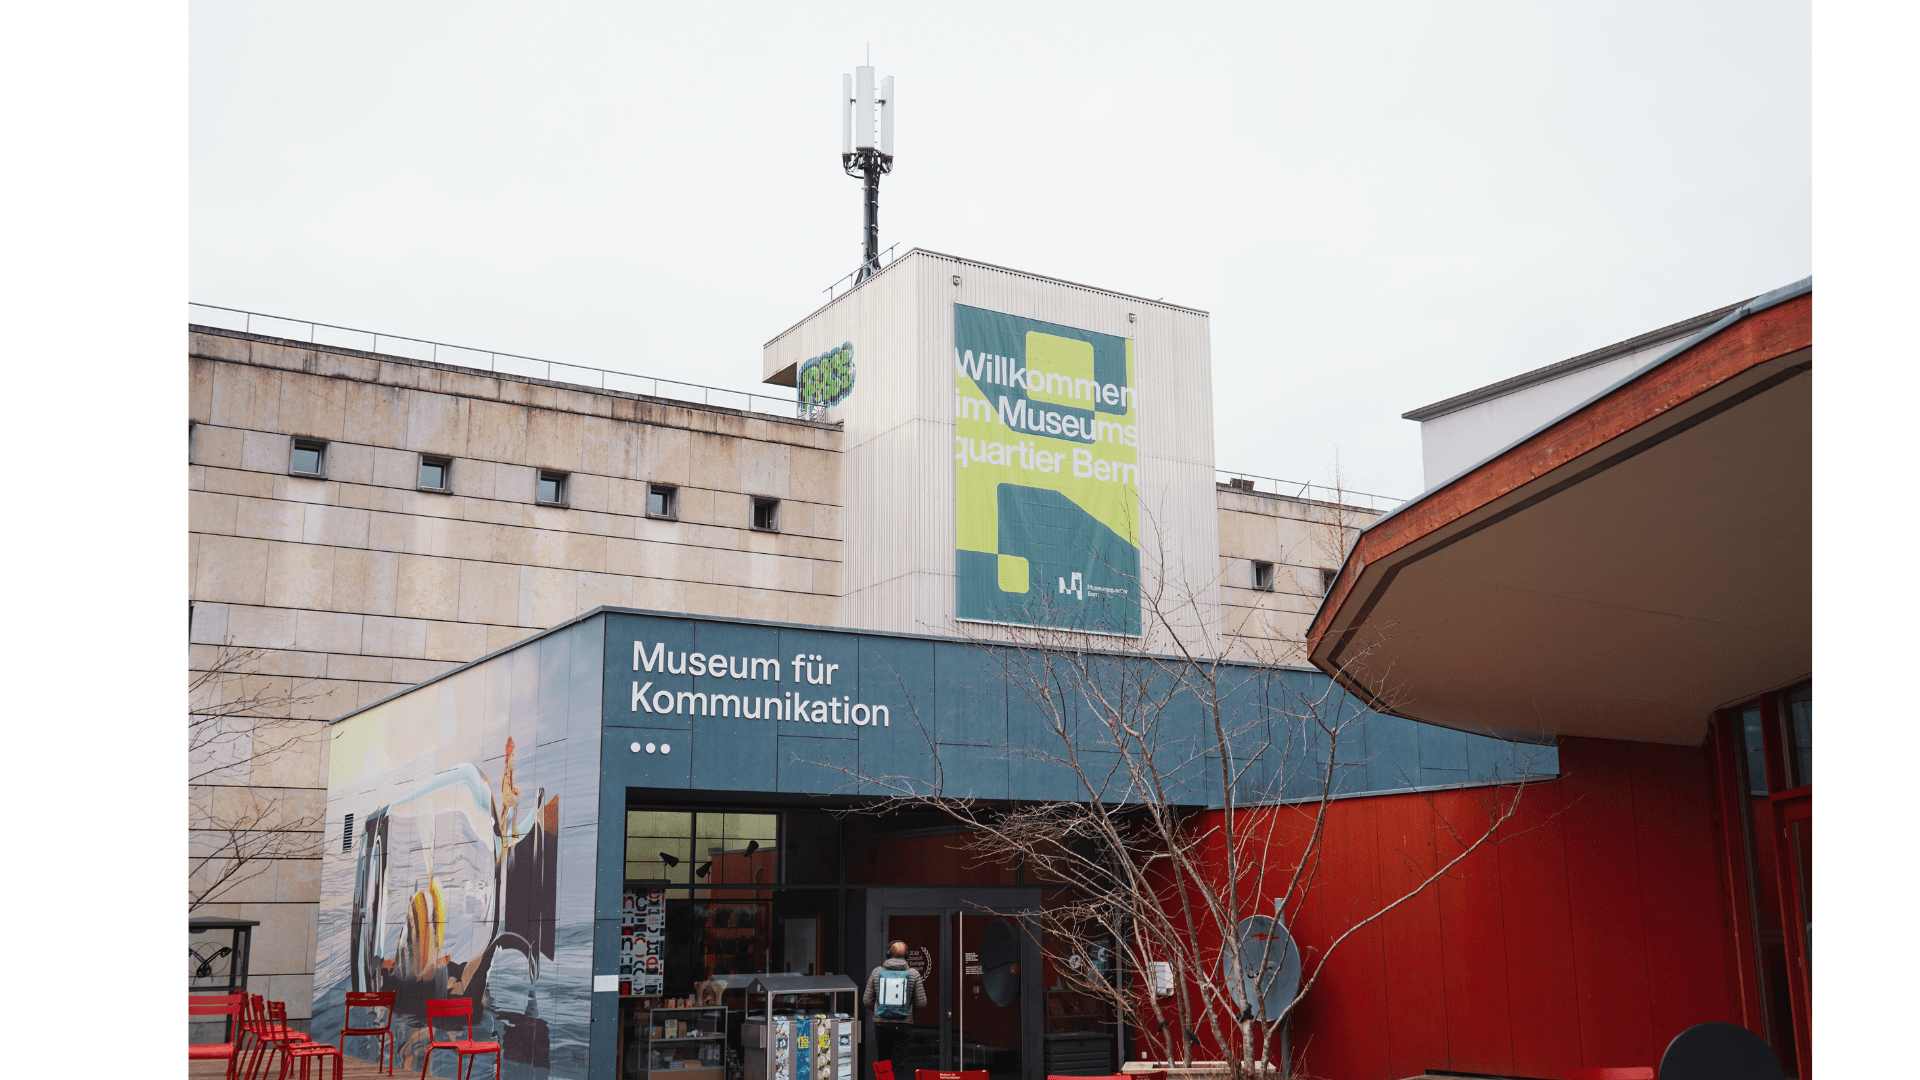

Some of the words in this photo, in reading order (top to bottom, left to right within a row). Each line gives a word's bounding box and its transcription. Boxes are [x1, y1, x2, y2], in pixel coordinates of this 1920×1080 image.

[955, 348, 1137, 409] Willkommen
[956, 388, 991, 422] im
[998, 395, 1138, 448] Museums
[956, 435, 1065, 474] quartier
[1072, 447, 1139, 486] Bern
[632, 640, 781, 682] Museum
[791, 653, 839, 686] für
[631, 681, 890, 727] Kommunikation
